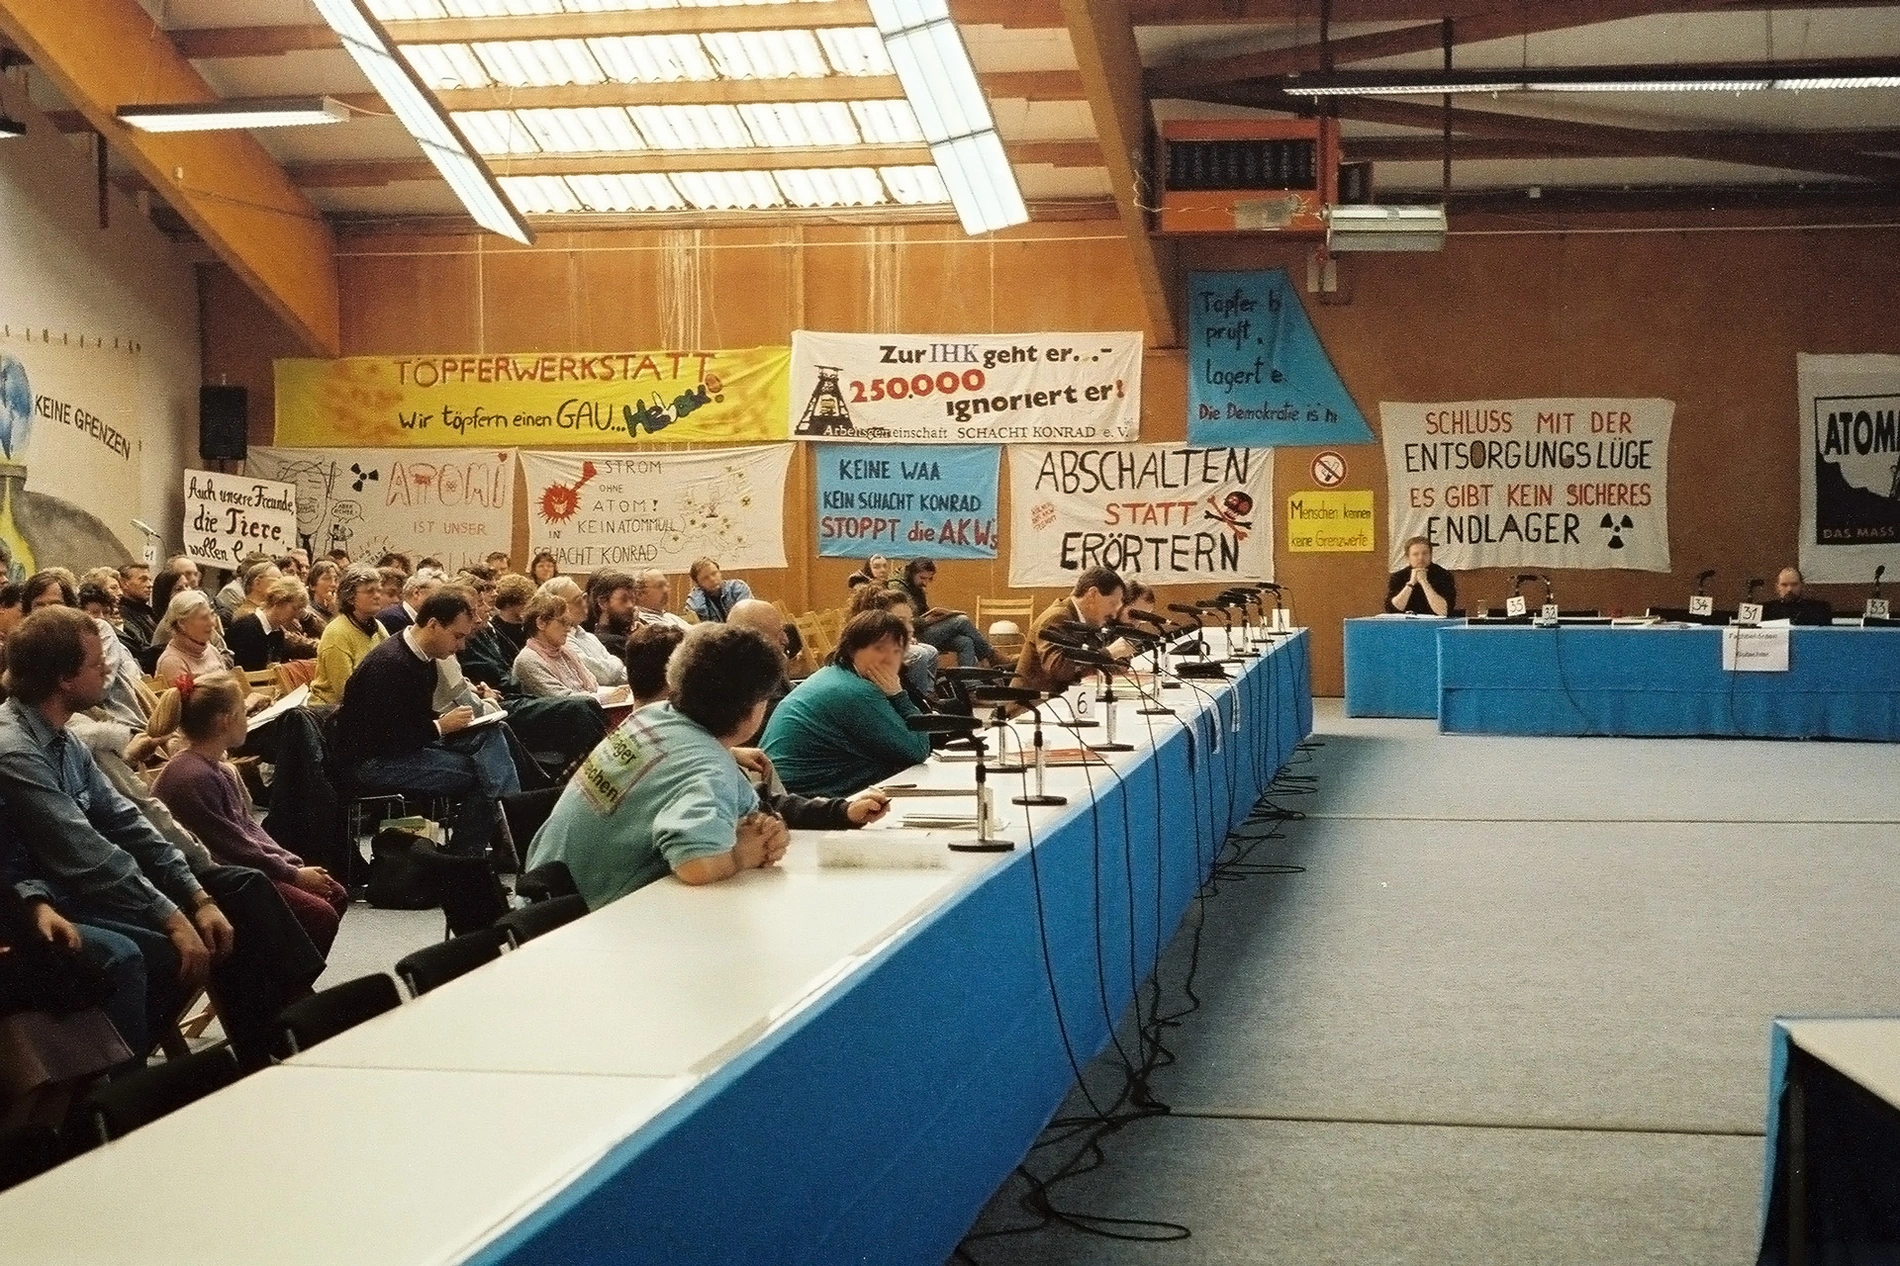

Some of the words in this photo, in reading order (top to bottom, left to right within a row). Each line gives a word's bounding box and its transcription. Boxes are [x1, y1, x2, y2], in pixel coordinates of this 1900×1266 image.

[880, 346, 927, 363] Zur
[929, 344, 979, 362] IHK
[983, 346, 1037, 368] geht
[394, 352, 715, 388] TÖPFERWERKSTATT
[1206, 357, 1264, 393] lagert
[850, 369, 985, 403] 250.000
[947, 385, 1078, 422] ignoriert
[1085, 379, 1124, 401] er!
[1199, 403, 1220, 420] Die
[1226, 401, 1299, 420] Demokratie
[35, 394, 71, 425] KEINE
[74, 408, 130, 461] GRENZEN
[399, 411, 434, 429] Wir
[441, 404, 508, 435] töpfern
[513, 411, 552, 427] einen
[1426, 409, 1513, 435] SCHLUSS
[1537, 411, 1575, 434] MIT
[1591, 411, 1632, 433] DER
[958, 427, 1028, 439] SCHACHT
[1033, 426, 1095, 438] KONRAD
[1824, 410, 1900, 456] ATOM
[605, 460, 662, 474] STROM
[839, 459, 890, 480] KEINE
[901, 462, 941, 480] WAA
[1035, 448, 1250, 494] ABSCHALTEN
[187, 476, 216, 501] Auch
[220, 488, 253, 507] unsere
[252, 484, 296, 516] Freunde,
[599, 484, 624, 493] OHNE
[823, 490, 854, 509] KEIN
[858, 491, 914, 510] SCHACHT
[920, 494, 981, 512] KONRAD
[1411, 487, 1435, 508] ES
[1445, 484, 1494, 508] GIBT
[1507, 484, 1552, 507] KEIN
[1566, 483, 1651, 507] SICHERES
[194, 504, 218, 533] die
[1104, 501, 1197, 526] STATT
[1291, 500, 1337, 519] Menschen
[414, 521, 434, 533] IST
[444, 522, 487, 536] UNSER
[549, 530, 561, 539] IN
[821, 516, 900, 541] STOPPT
[907, 520, 935, 541] die
[1292, 534, 1312, 547] keine
[1316, 530, 1368, 547] Grenzwerte
[1427, 513, 1580, 547] ENDLAGER
[1823, 528, 1851, 539] DAS
[188, 537, 229, 562] wollen
[601, 544, 658, 564] KONRAD
[1060, 531, 1239, 573] ERÖRTERN
[1693, 598, 1708, 610] 34
